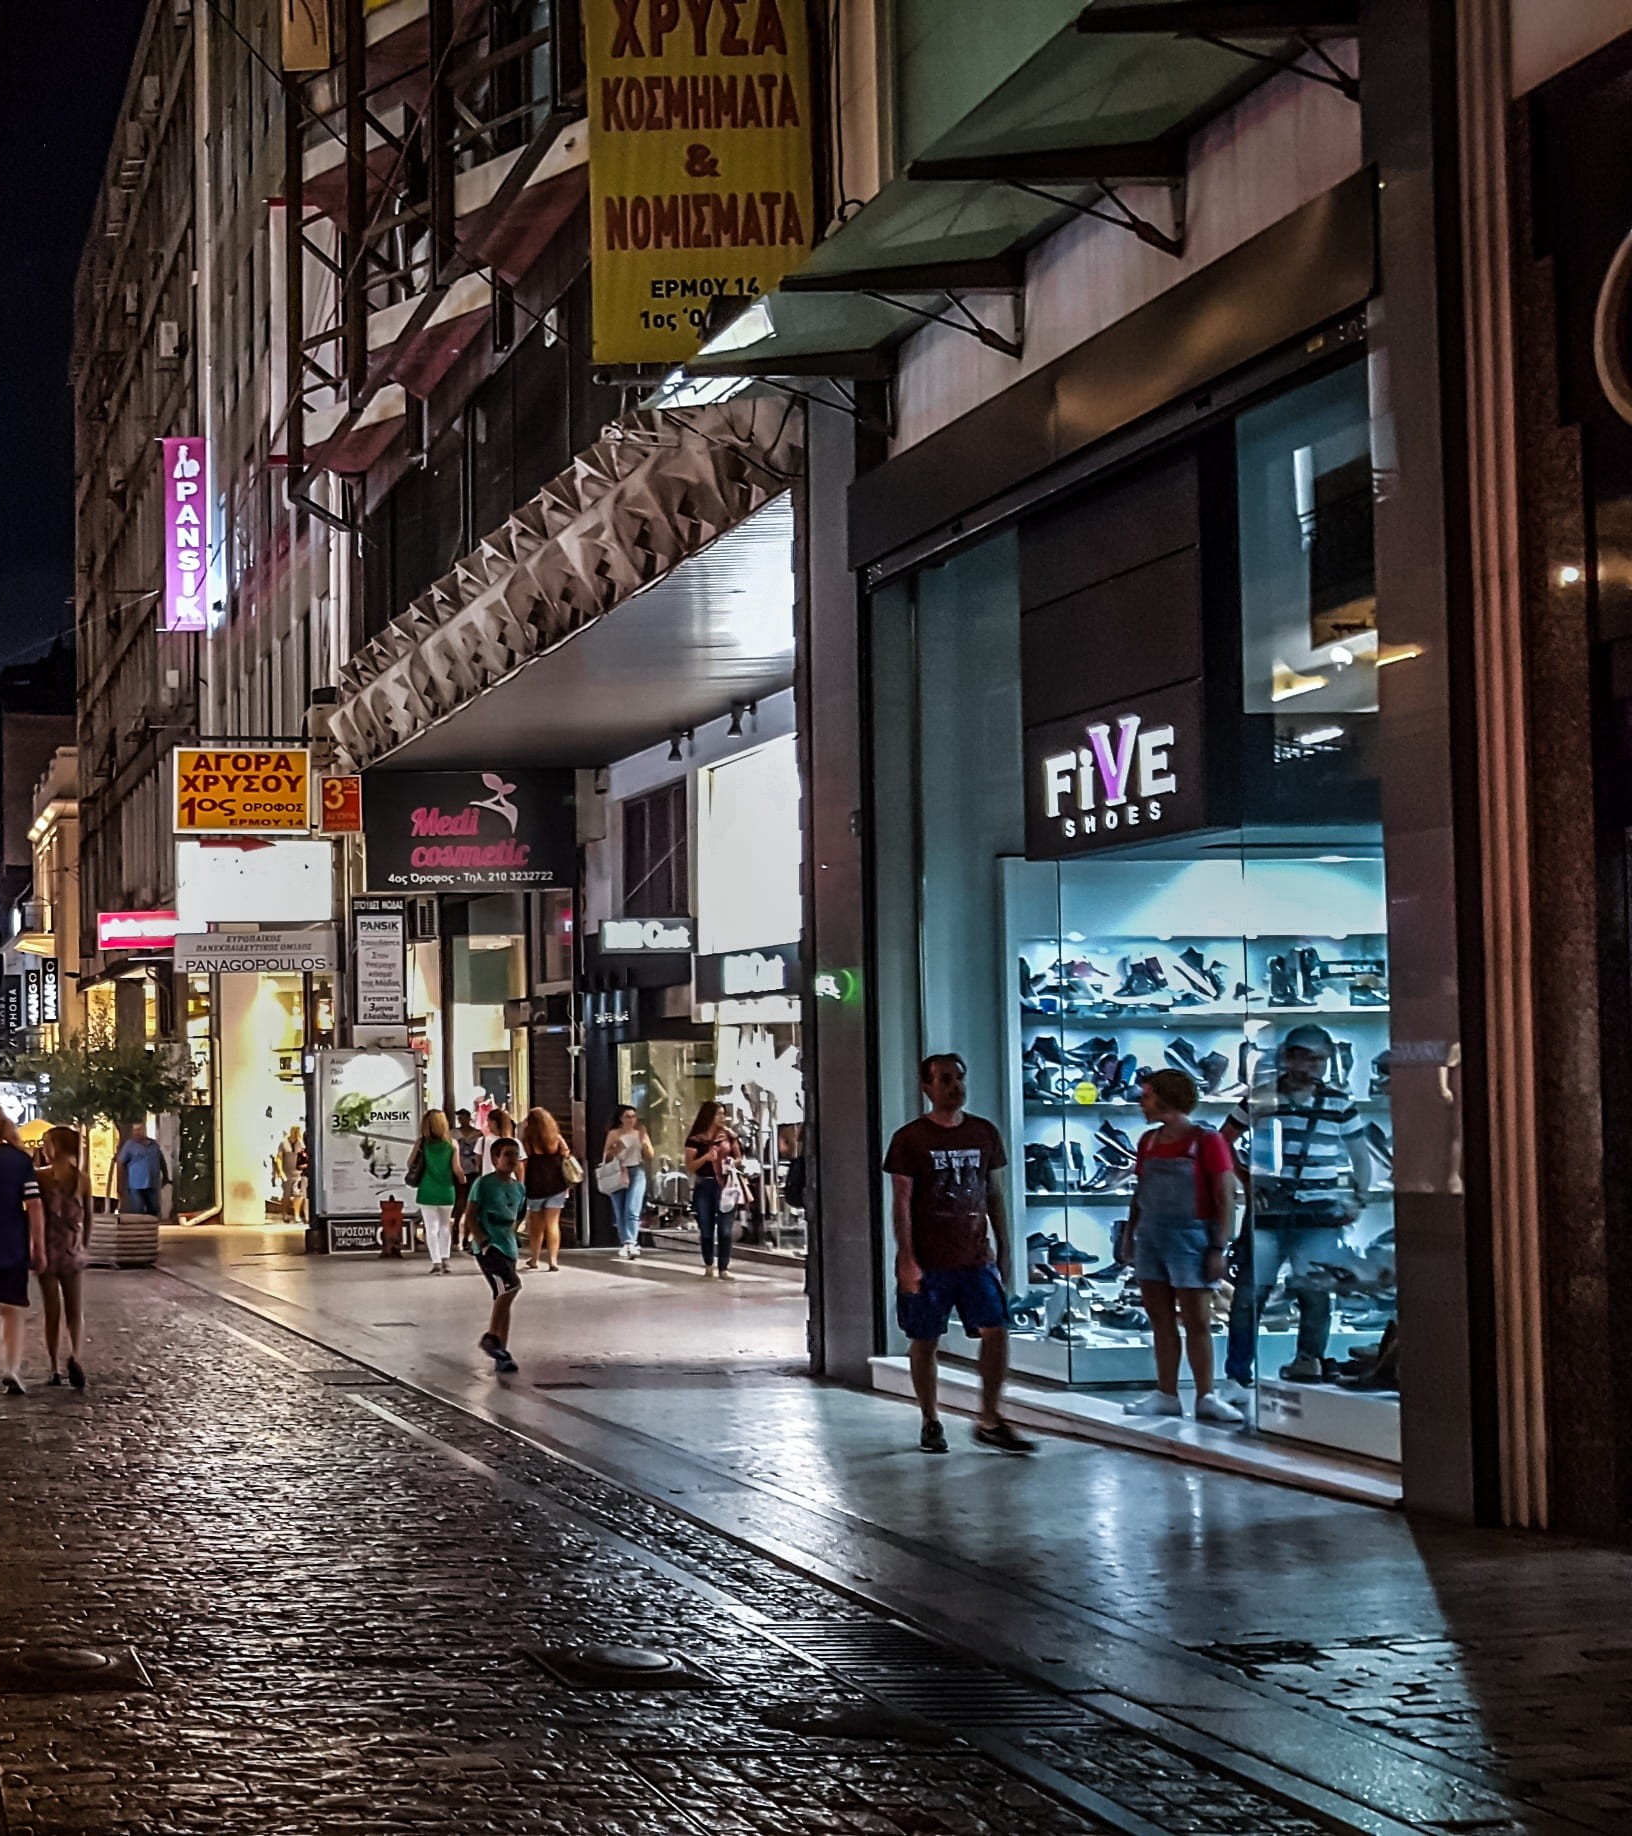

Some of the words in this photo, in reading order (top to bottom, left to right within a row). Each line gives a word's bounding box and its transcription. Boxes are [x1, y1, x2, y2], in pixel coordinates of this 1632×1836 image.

[611, 0, 788, 58] ΧΡΥΣΑ
[601, 74, 800, 131] ΚΟΣΜΗΜΑΤΑ
[683, 143, 721, 178] &
[605, 191, 804, 250] ΝΟΜΙΣΜΑΤΑ
[651, 278, 727, 298] ΕΡΜΟΥ
[734, 277, 760, 296] 14
[640, 310, 677, 332] 1ος
[192, 754, 293, 772] ΑΓΟΡΑ
[1043, 713, 1176, 818] FiVE
[180, 775, 305, 793] ΧΡΥΣΟΥ
[180, 797, 237, 825] 1ος
[243, 803, 304, 812] ΟΡΟΦΟΣ
[410, 807, 480, 837] Medi
[1063, 801, 1161, 838] SHOES
[410, 838, 531, 867] cosmetic
[387, 873, 408, 885] 4ος
[488, 872, 507, 881] 210
[186, 958, 326, 972] PANAGOPOULOS
[28, 972, 39, 1026] MANGO
[44, 961, 57, 1020] MANGO
[335, 1226, 375, 1237] ΠΡΟΣΟΧΗ
